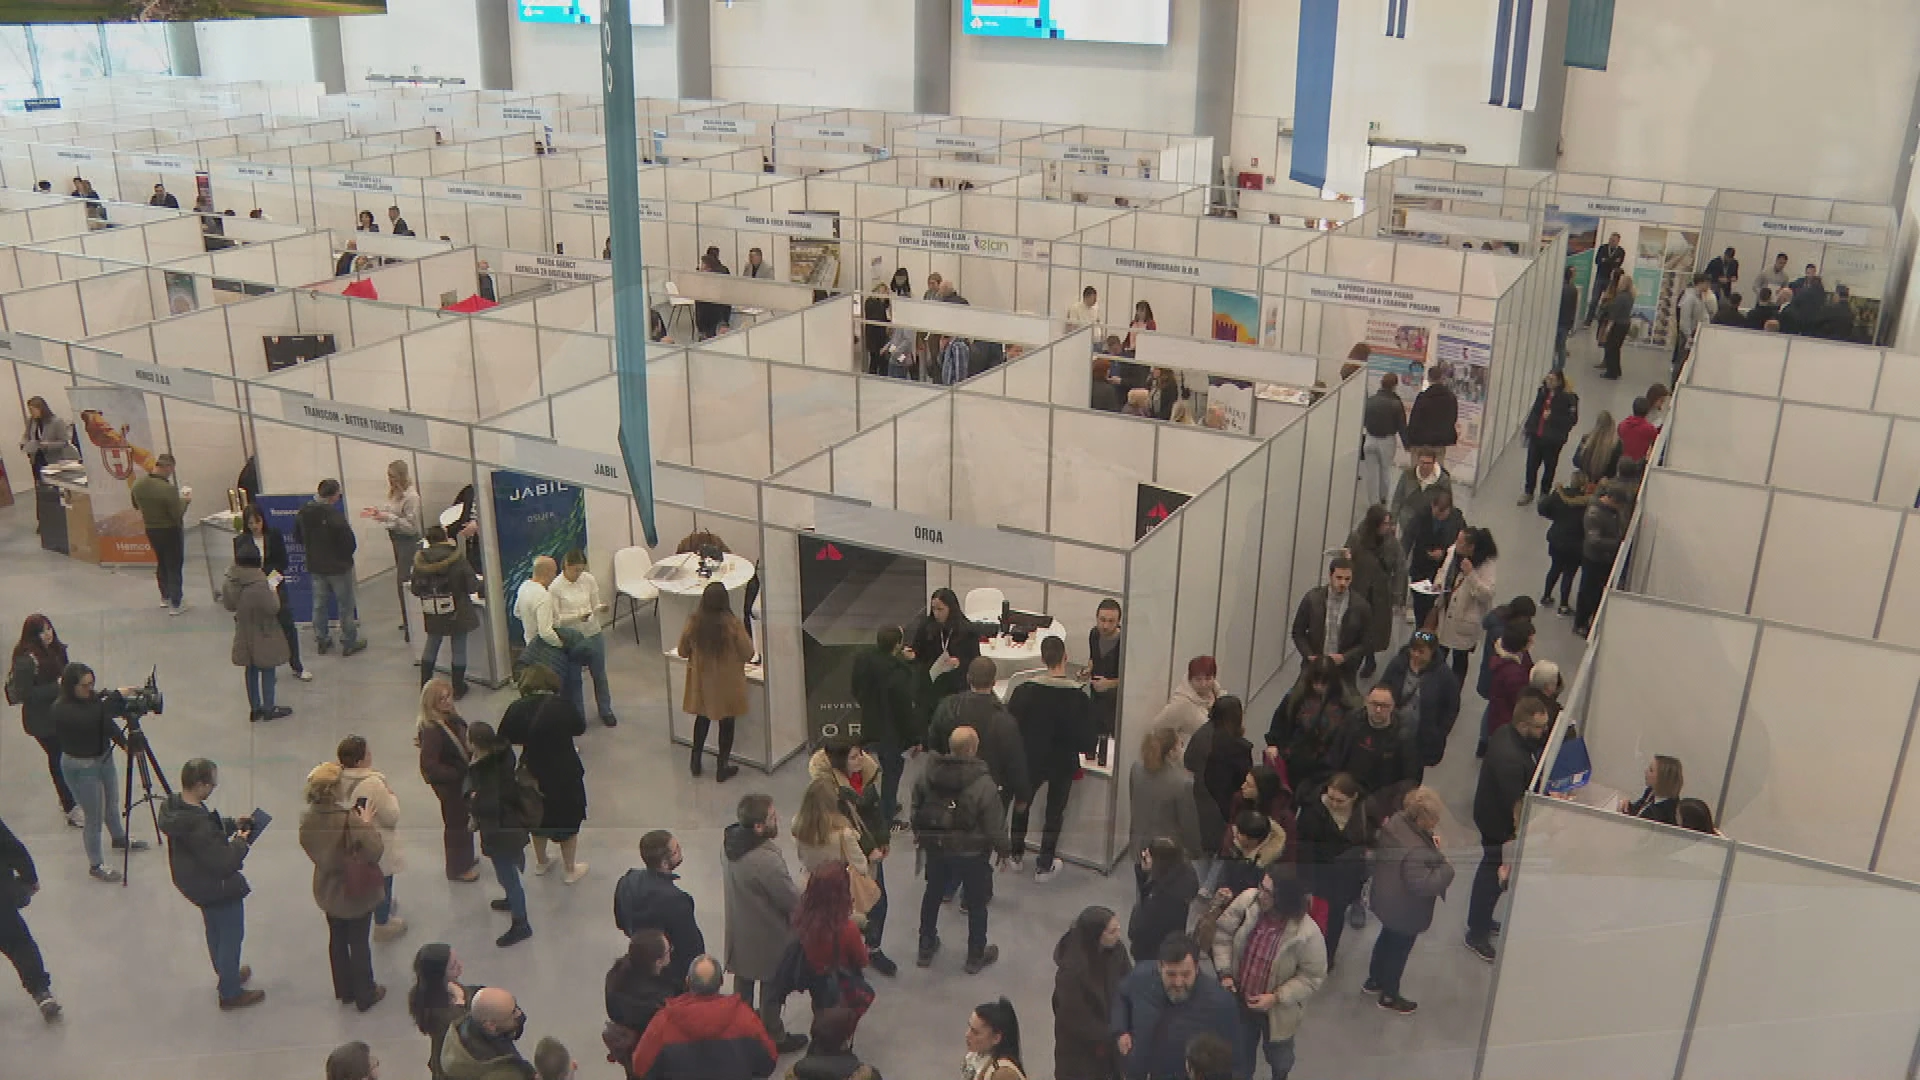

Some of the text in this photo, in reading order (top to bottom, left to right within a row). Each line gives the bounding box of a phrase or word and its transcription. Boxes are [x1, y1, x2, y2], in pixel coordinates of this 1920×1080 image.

[303, 405, 340, 423] TRANSCOM
[345, 413, 369, 429] BETTER
[369, 418, 405, 436] TOGETHER
[594, 463, 618, 479] JABIL
[509, 480, 569, 501] JABIL
[914, 525, 944, 544] ORQA
[116, 541, 152, 551] Hemco
